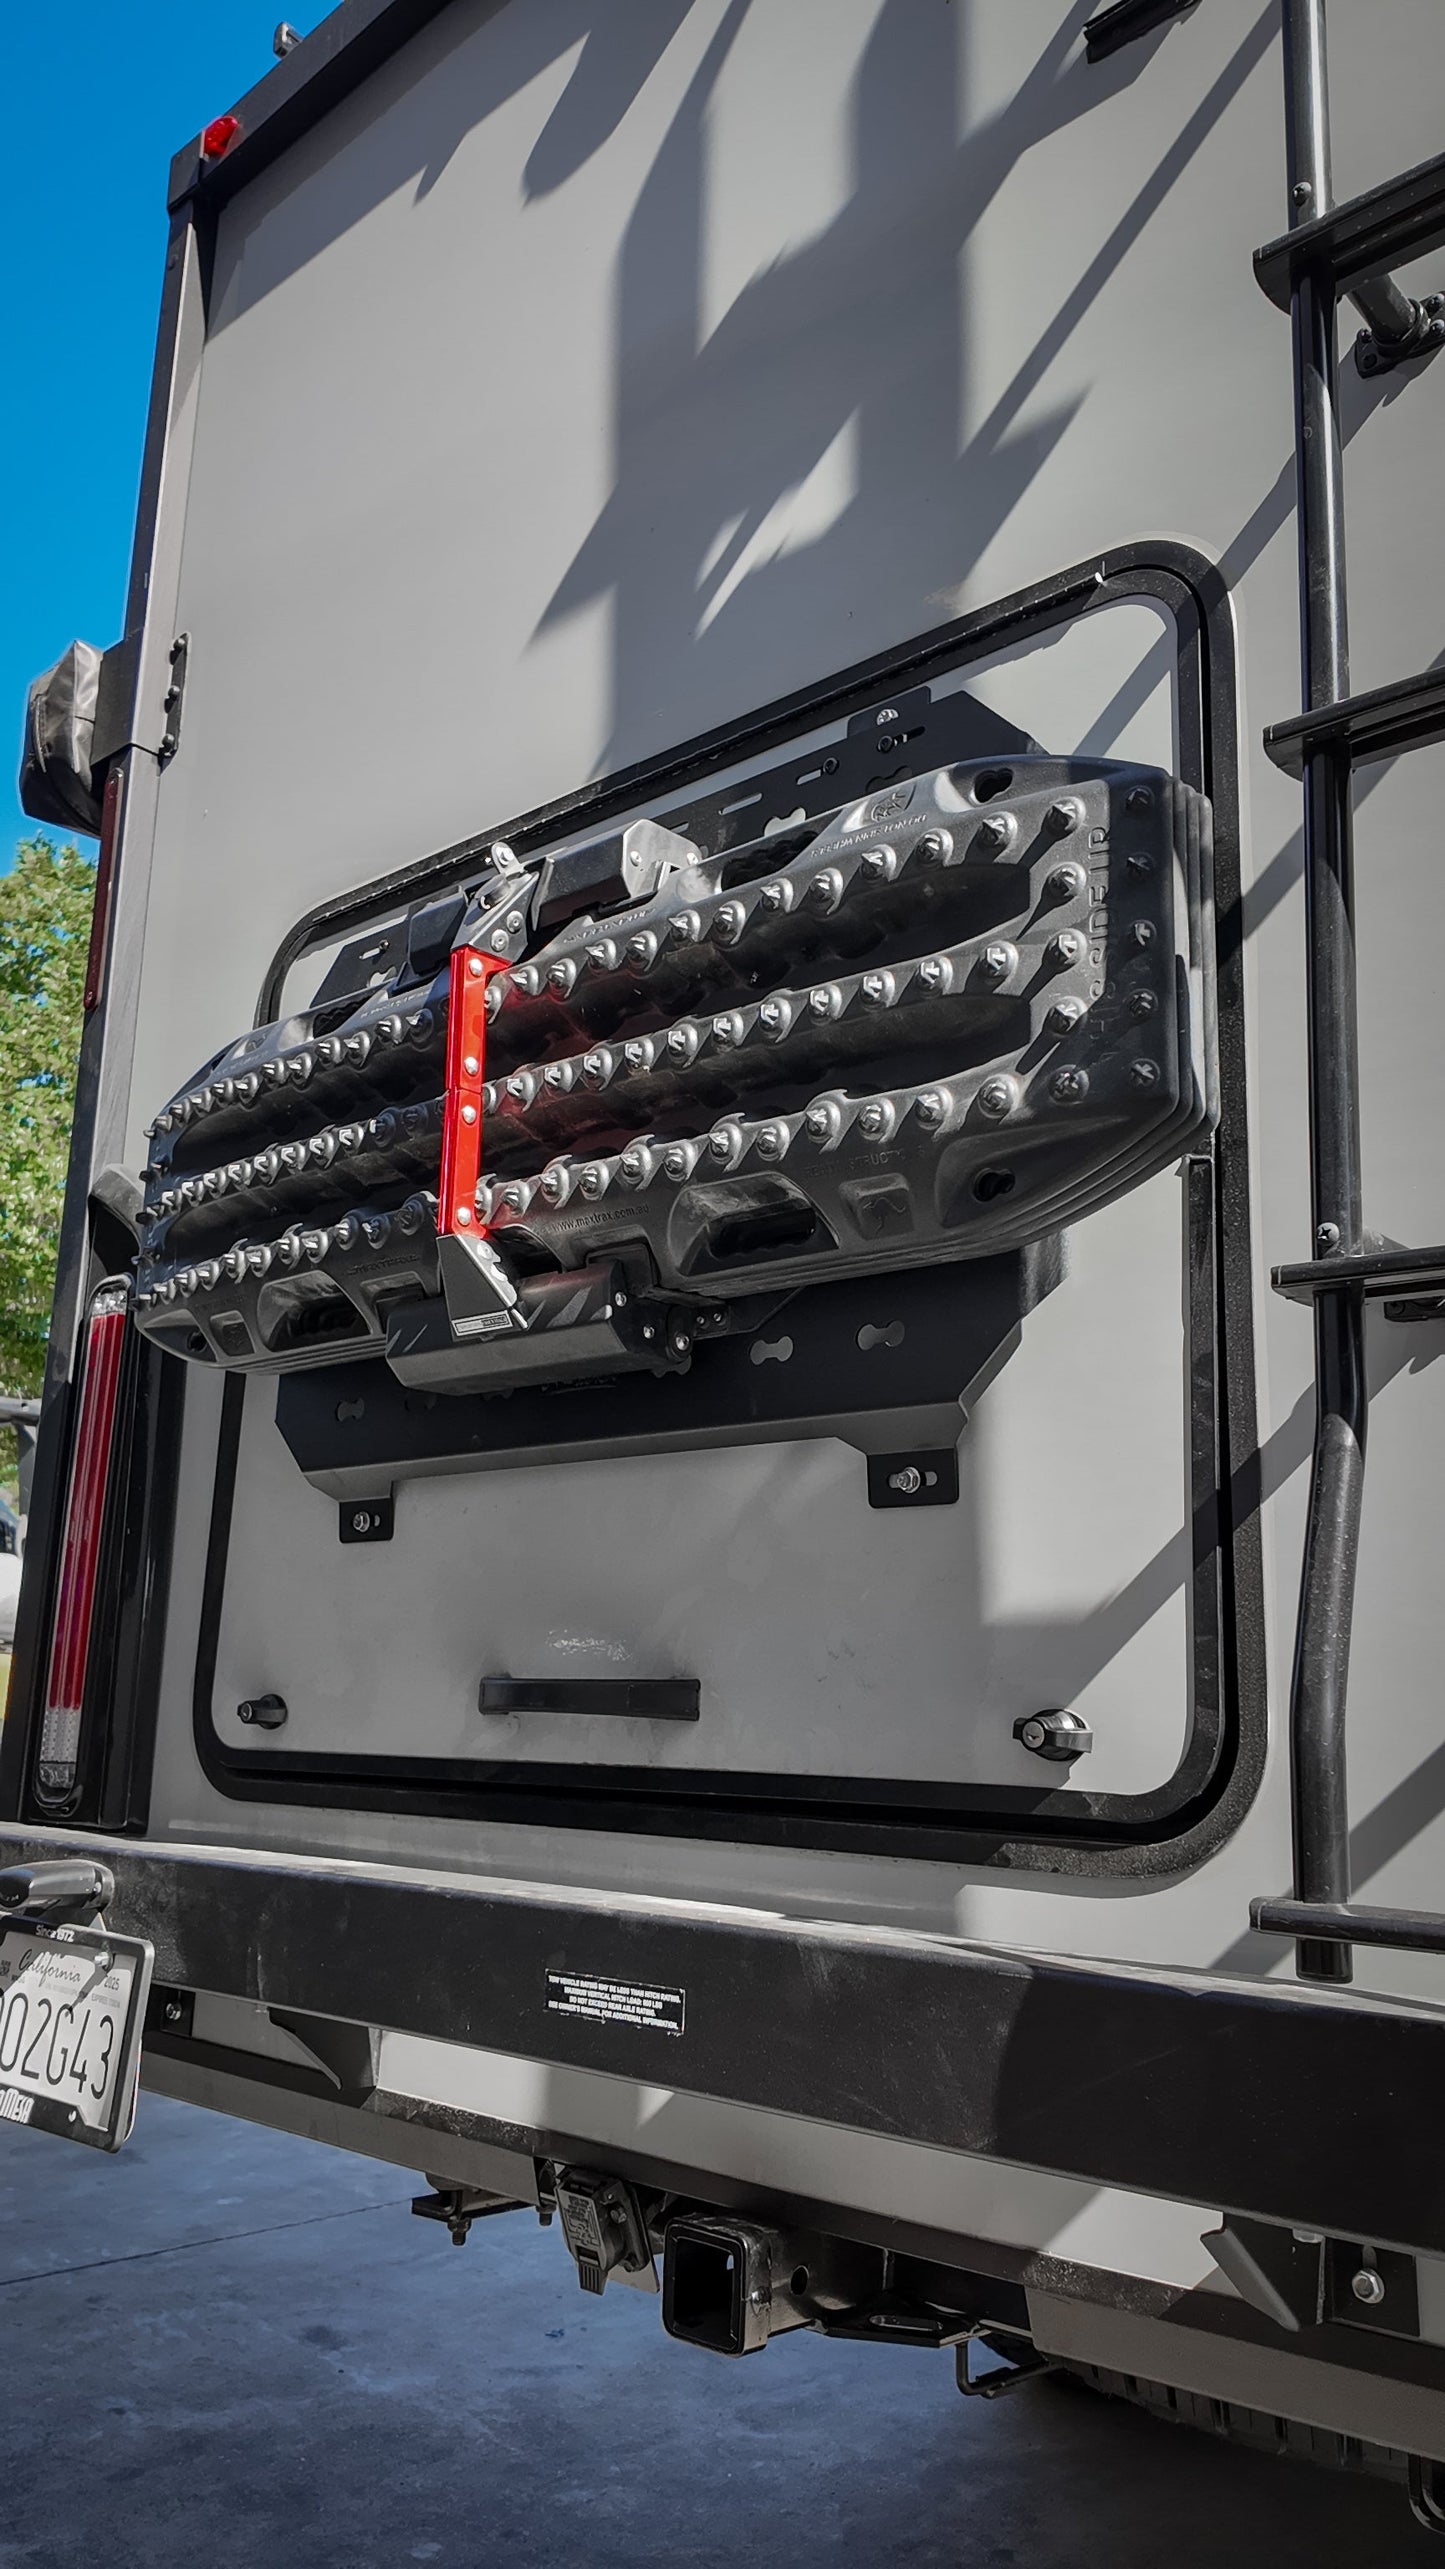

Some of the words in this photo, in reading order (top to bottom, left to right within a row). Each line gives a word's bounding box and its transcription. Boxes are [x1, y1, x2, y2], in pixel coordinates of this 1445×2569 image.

[552, 1204, 649, 1232] www.maxtrax.com.au
[19, 1948, 81, 1988] California
[0, 1987, 115, 2100] 02G43
